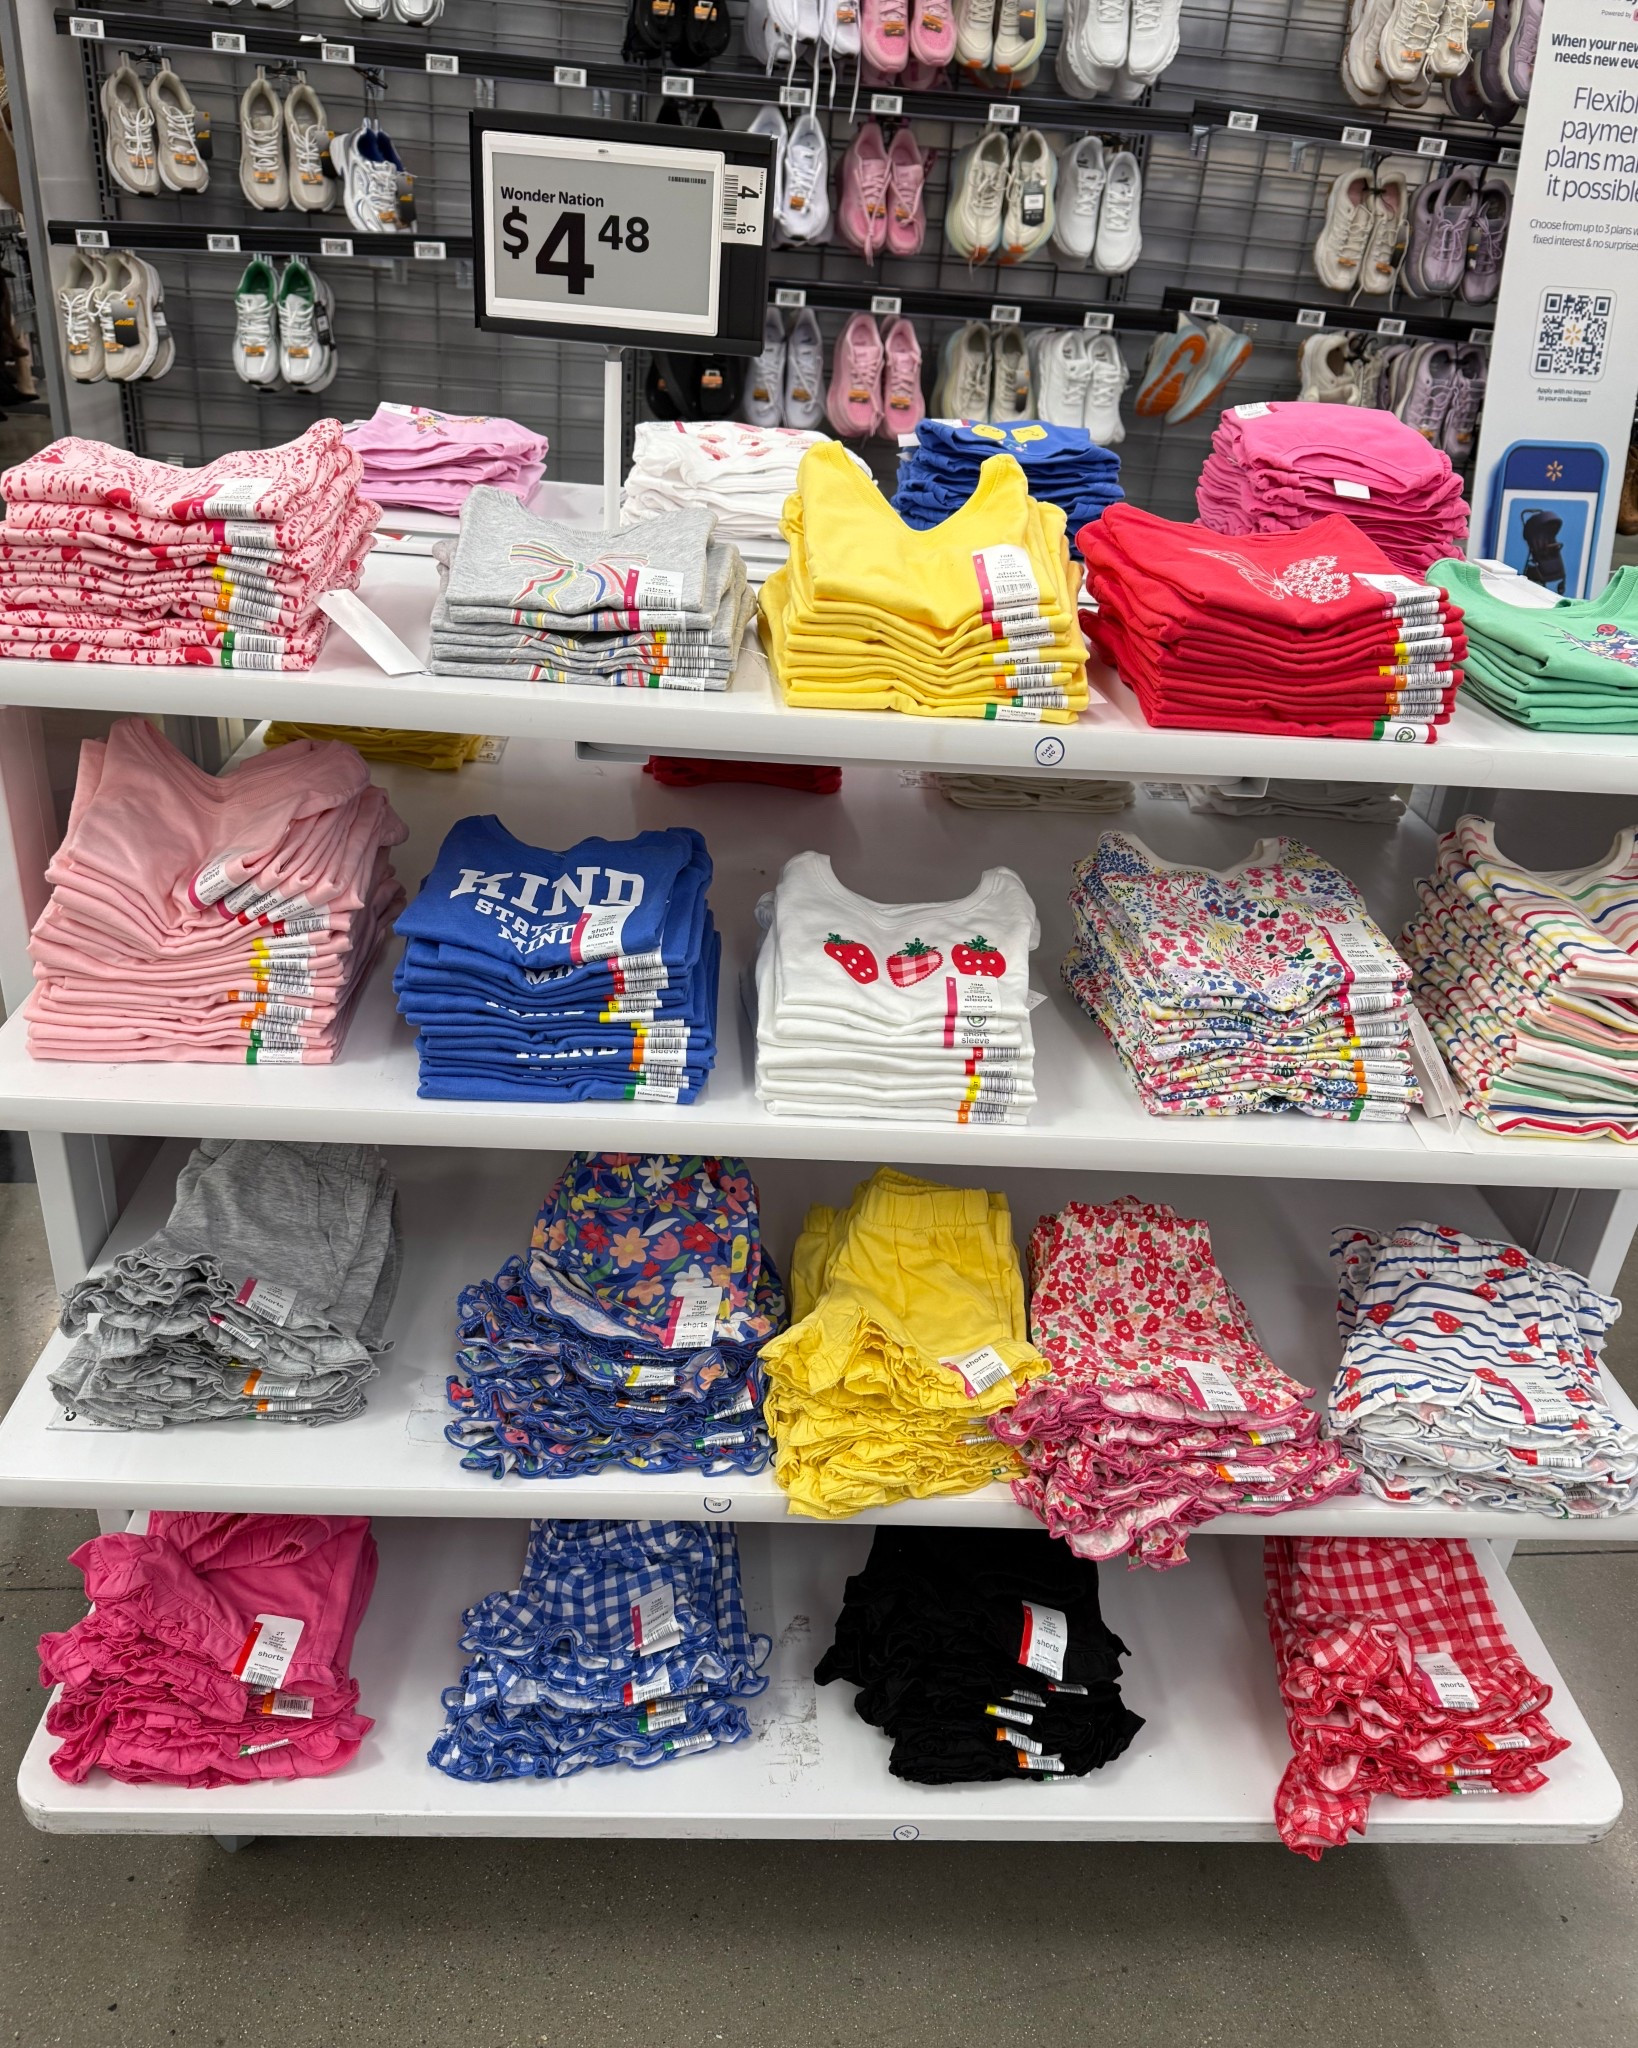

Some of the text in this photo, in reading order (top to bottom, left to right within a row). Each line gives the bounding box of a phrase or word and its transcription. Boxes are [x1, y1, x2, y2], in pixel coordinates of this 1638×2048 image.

[1601, 9, 1625, 17] Powered
[1552, 33, 1587, 48] When
[1589, 38, 1618, 51] your
[1554, 51, 1592, 65] needs
[1593, 54, 1620, 67] new
[1544, 145, 1638, 174] plans ma
[737, 185, 760, 200] 4
[1546, 174, 1561, 197] it
[500, 185, 604, 208] Wonder Nation
[736, 222, 746, 235] 18
[746, 225, 757, 233] C
[1530, 218, 1562, 230] Choose
[1562, 220, 1583, 232] from
[1583, 223, 1595, 234] up
[1595, 223, 1604, 233] to
[1604, 223, 1610, 233] 3
[1610, 224, 1632, 236] plans
[1533, 233, 1554, 245] fixed
[1554, 235, 1585, 247] interest
[1585, 237, 1592, 247] &
[1592, 239, 1604, 249] no
[1004, 656, 1030, 665] short
[450, 866, 644, 917] KIND
[252, 898, 278, 916] sleeve
[587, 931, 615, 940] sleeve
[591, 926, 614, 934] short
[498, 922, 578, 955] MIND
[961, 1037, 990, 1045] sleeve
[965, 1352, 989, 1369] shorts
[1037, 1639, 1060, 1653] shorts
[257, 1651, 284, 1662] shorts
